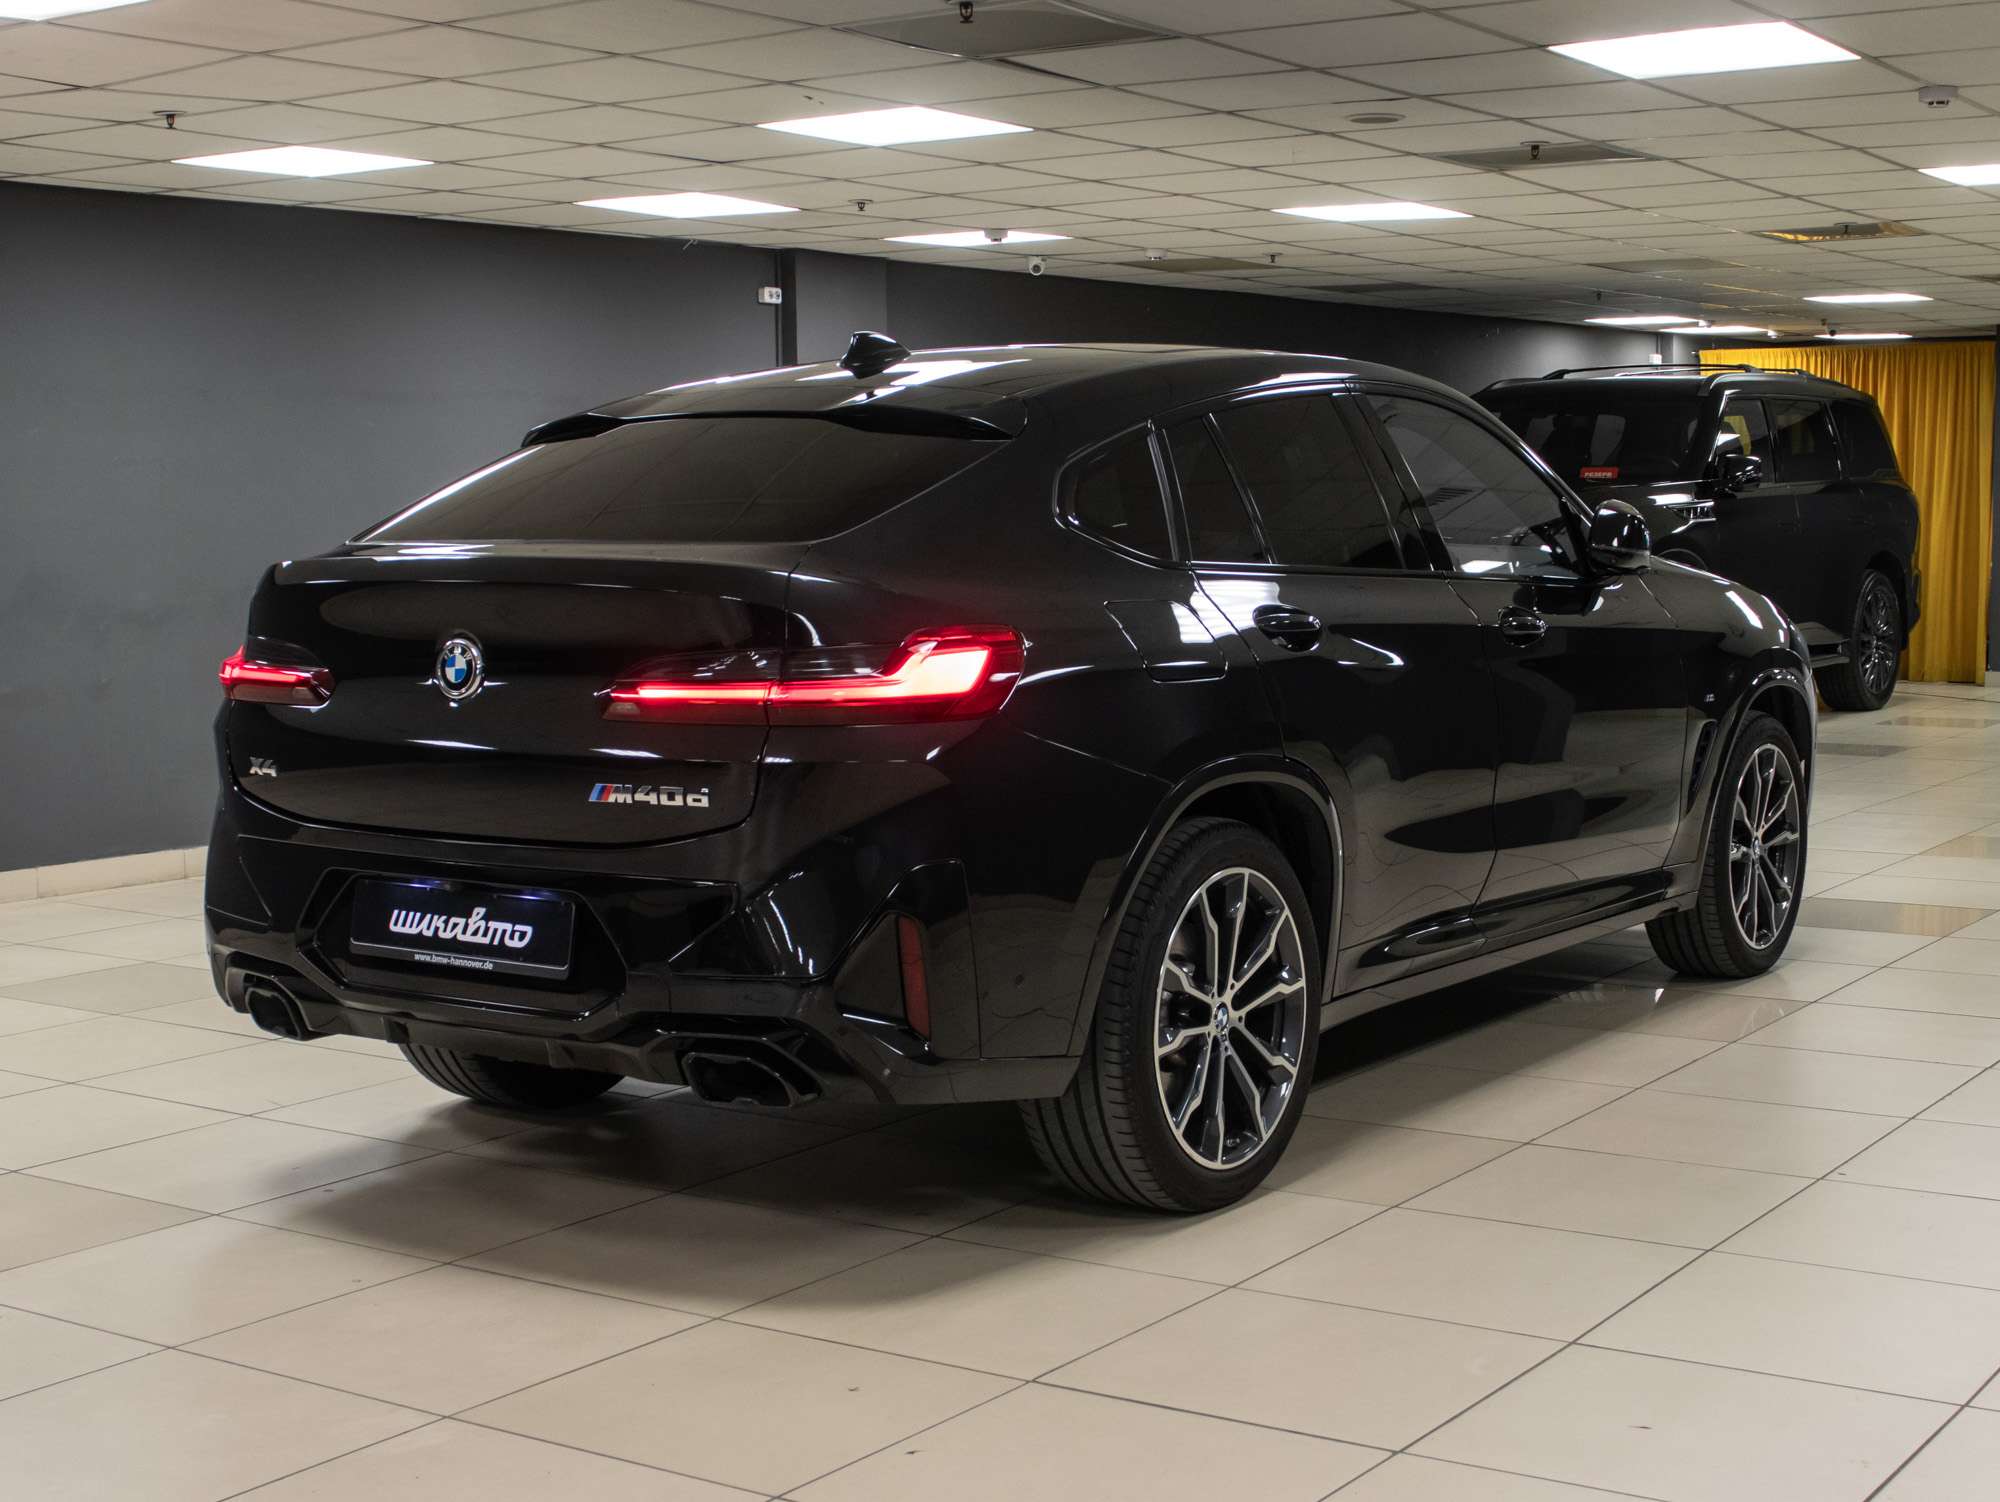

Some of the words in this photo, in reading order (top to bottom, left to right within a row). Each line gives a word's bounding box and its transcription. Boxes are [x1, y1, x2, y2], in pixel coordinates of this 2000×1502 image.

[249, 756, 277, 777] X4
[607, 784, 709, 807] M40d
[414, 953, 494, 970] www.bmw-hannover.de
